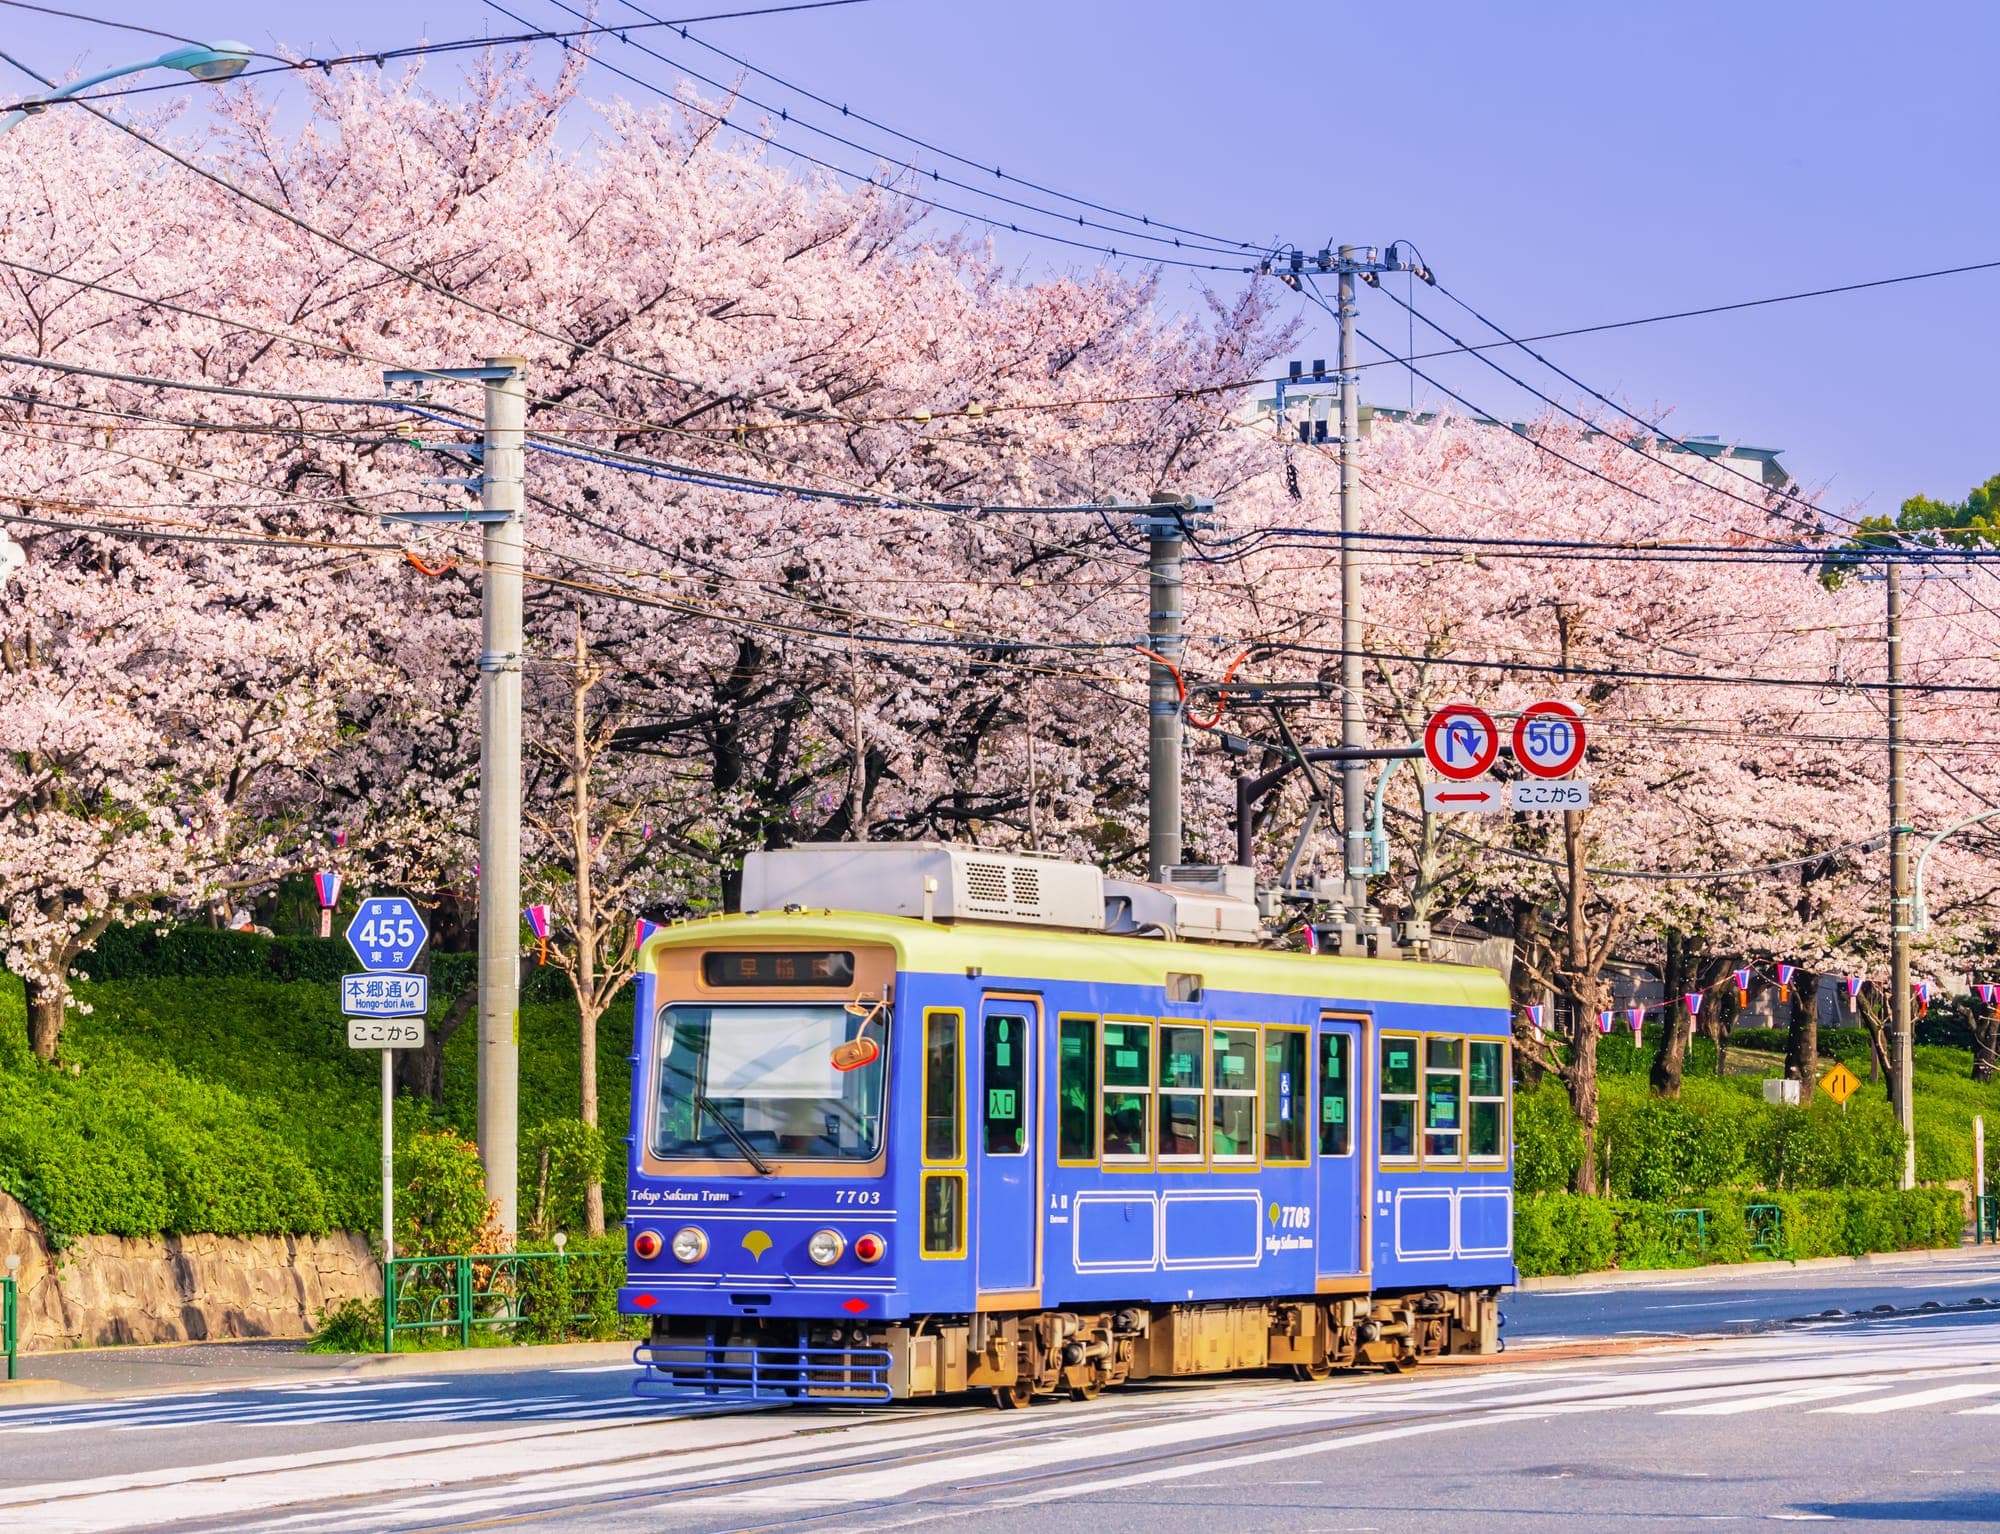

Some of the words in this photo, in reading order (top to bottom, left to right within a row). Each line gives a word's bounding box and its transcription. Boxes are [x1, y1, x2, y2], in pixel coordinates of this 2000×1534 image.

[1529, 723, 1569, 757] 50
[1519, 787, 1582, 804] ここから
[371, 904, 402, 915] 都道
[359, 919, 415, 948] 455
[370, 951, 404, 963] 東京
[346, 980, 420, 998] 本郷通り
[355, 999, 398, 1010] Hongo-dori
[400, 999, 416, 1009] Ave.
[353, 1026, 419, 1041] ここから
[992, 1093, 1012, 1114] 入口
[631, 1190, 661, 1205] Tokyo
[662, 1190, 699, 1202] Sakura
[701, 1191, 729, 1202] Tram
[835, 1191, 881, 1205] 7703
[1050, 1193, 1068, 1209] 入口
[1282, 1206, 1311, 1228] 7703
